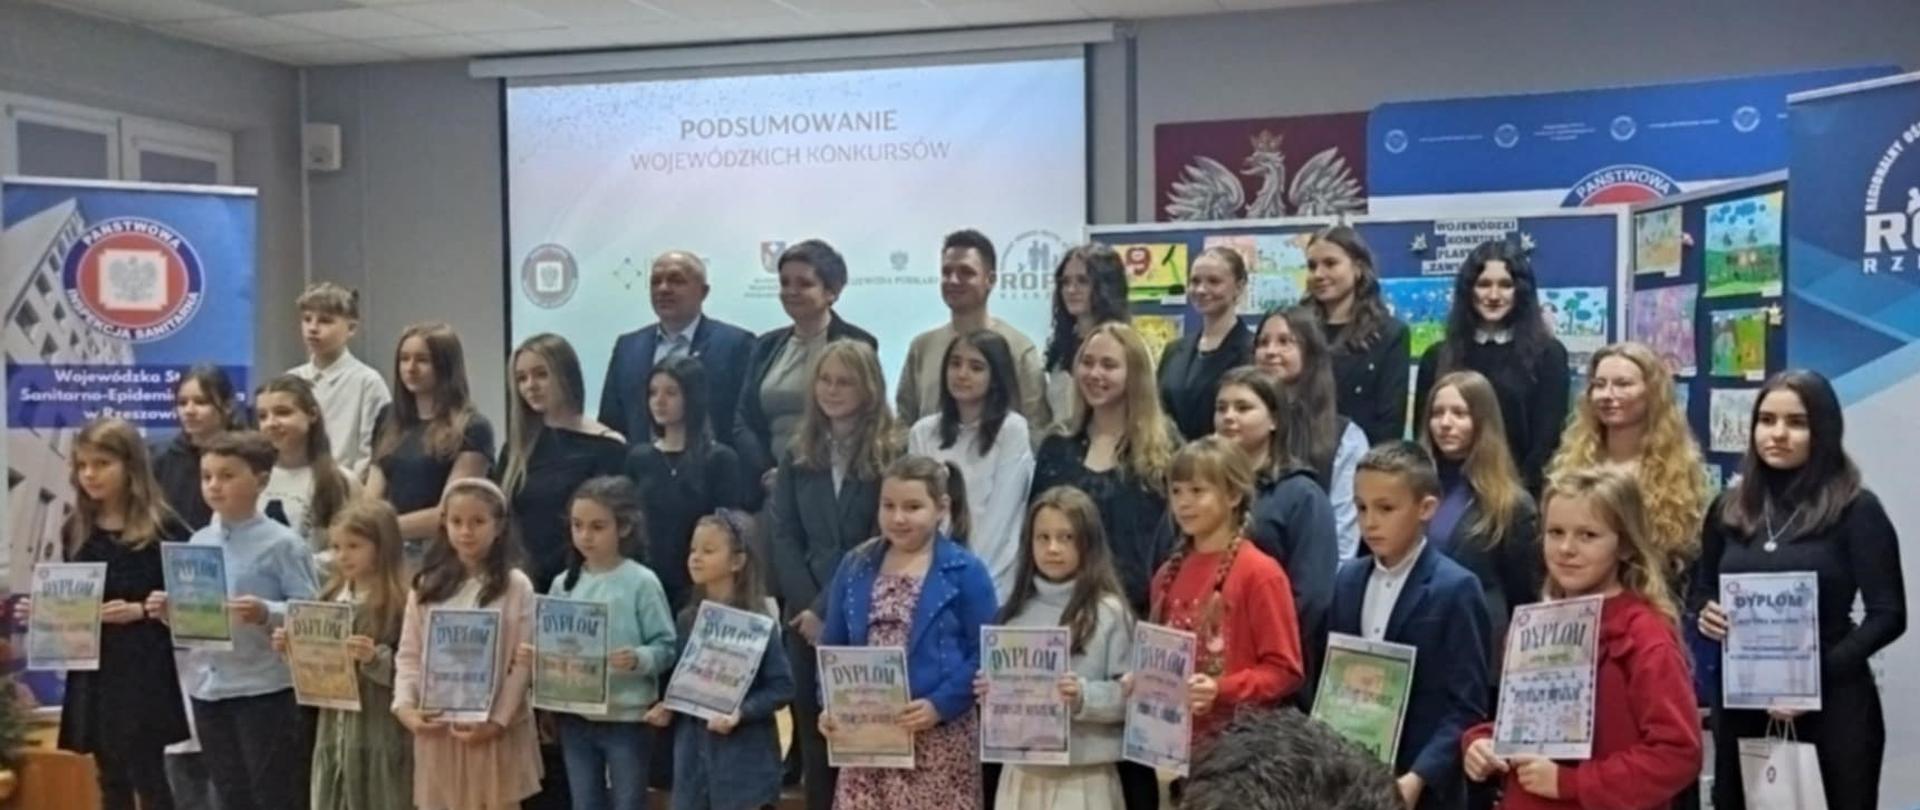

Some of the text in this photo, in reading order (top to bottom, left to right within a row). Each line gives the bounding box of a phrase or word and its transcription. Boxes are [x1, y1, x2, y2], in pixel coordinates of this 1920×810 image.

[680, 110, 898, 140] PODSUMOWANIE
[630, 138, 951, 174] WOJEWÓDZKICH KONKURSÓW
[1576, 169, 1671, 199] PAŃSTWOWA
[82, 220, 181, 249] PAŃSTWOWA
[1436, 220, 1516, 231] WOJEWÓDZKI
[67, 288, 200, 339] INSPEKCJA SANITARNA
[54, 369, 161, 384] Wojewódzka
[84, 407, 176, 420] w Rzeszowi
[1734, 593, 1804, 608] DYPLOM
[436, 625, 490, 646] DYPLOM
[544, 615, 599, 637] DYPLOM
[1520, 621, 1587, 652] DYPLOM
[990, 647, 1058, 672] DYPLOM
[831, 664, 896, 686] DYPLOM
